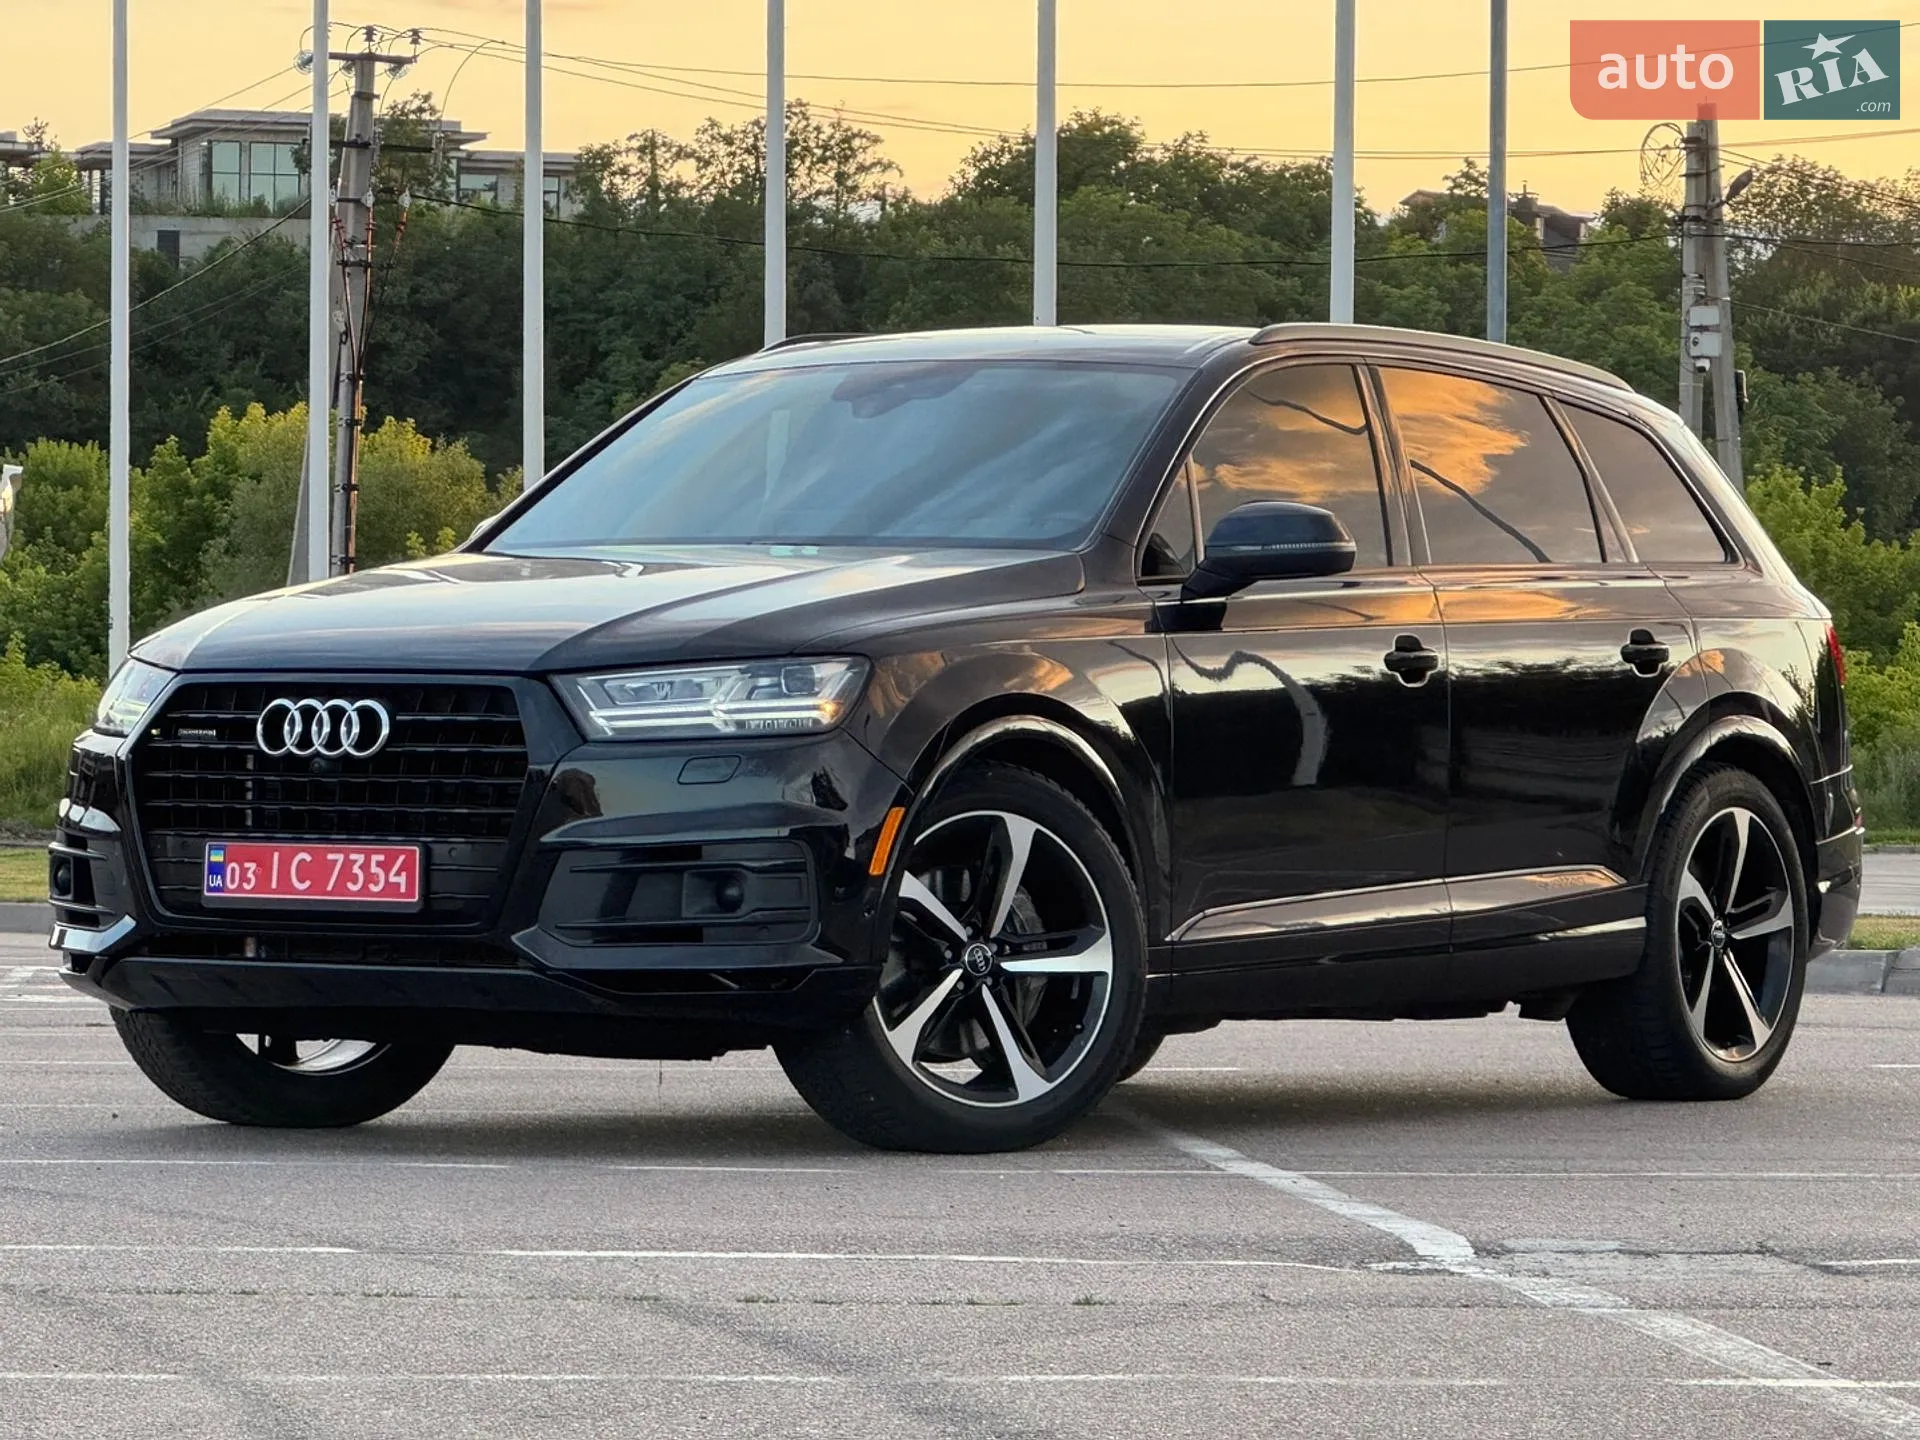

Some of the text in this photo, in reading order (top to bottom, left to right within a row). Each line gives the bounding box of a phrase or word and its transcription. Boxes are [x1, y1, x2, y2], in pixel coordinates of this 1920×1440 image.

[209, 874, 223, 888] UA
[226, 851, 407, 893] 03 IC 7354
